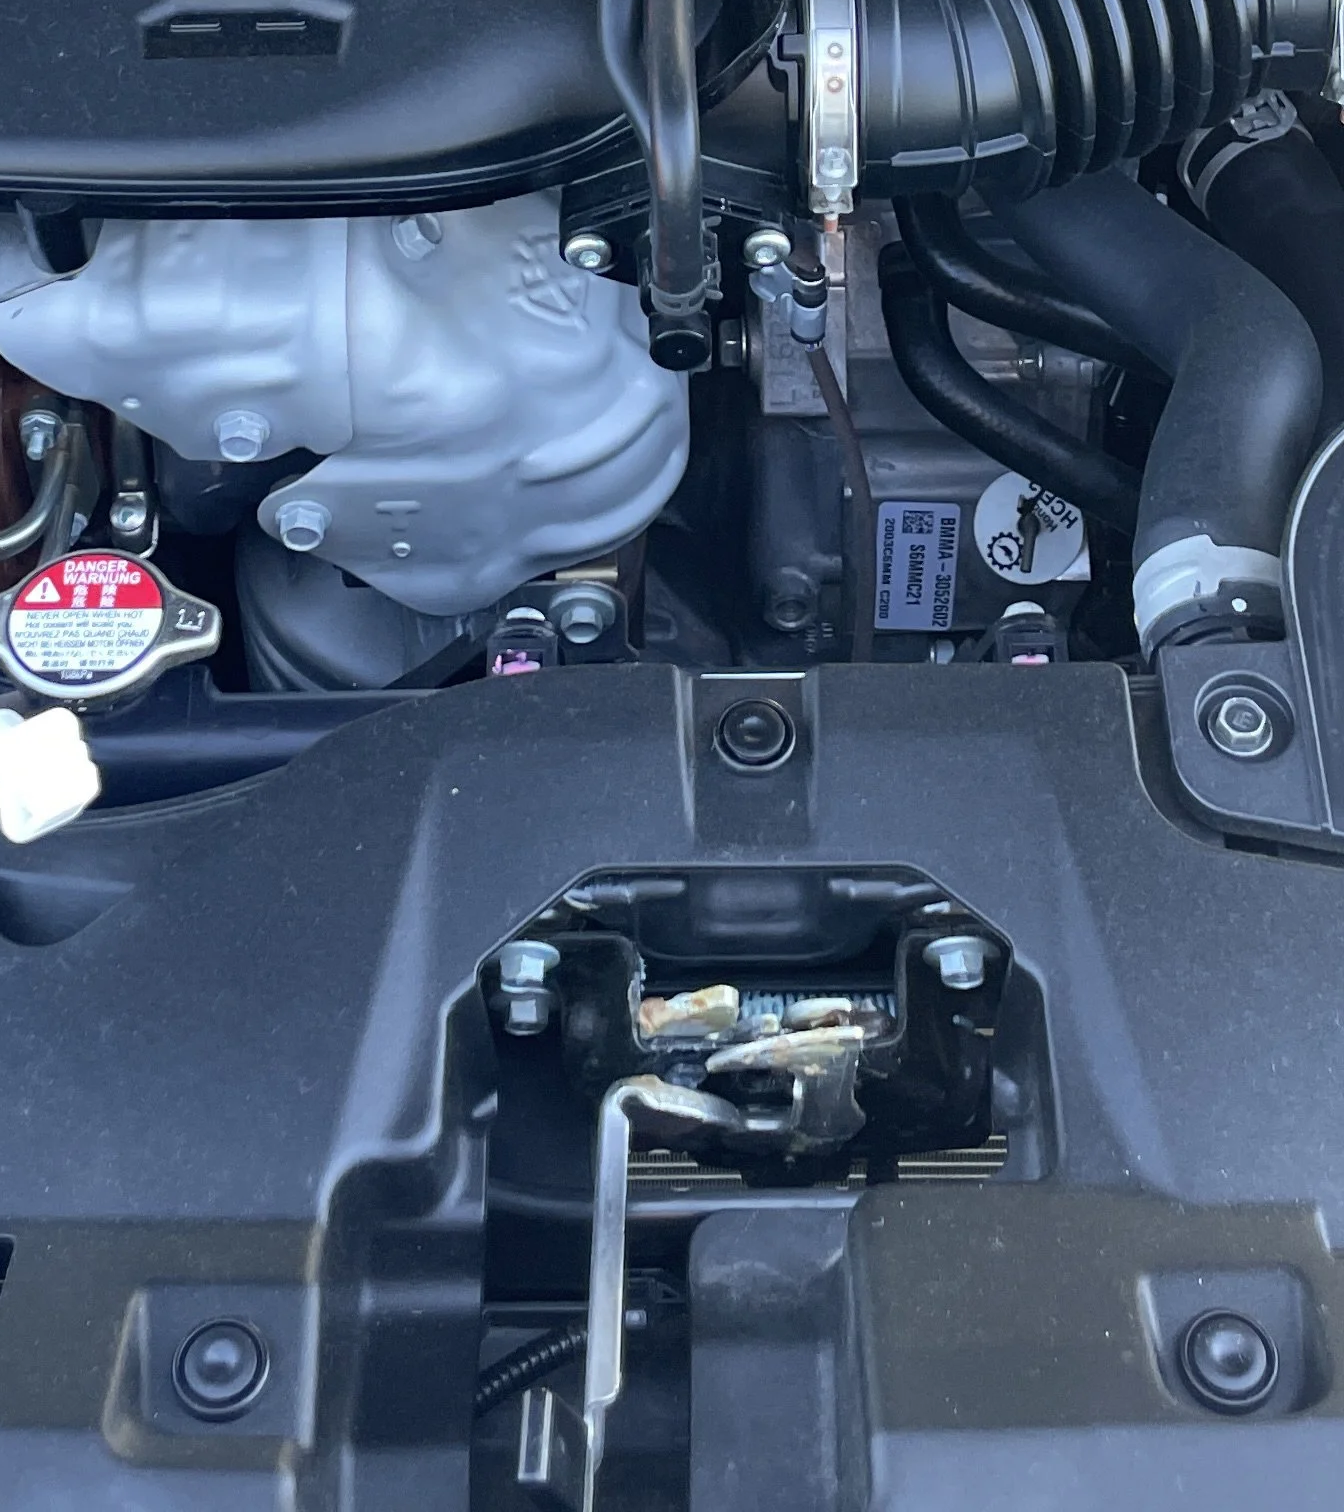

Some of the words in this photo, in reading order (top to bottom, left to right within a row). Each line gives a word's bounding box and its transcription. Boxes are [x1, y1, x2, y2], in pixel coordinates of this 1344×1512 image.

[64, 560, 129, 573] DANGER
[63, 571, 142, 585] WARNUNG
[123, 610, 144, 619] HOT
